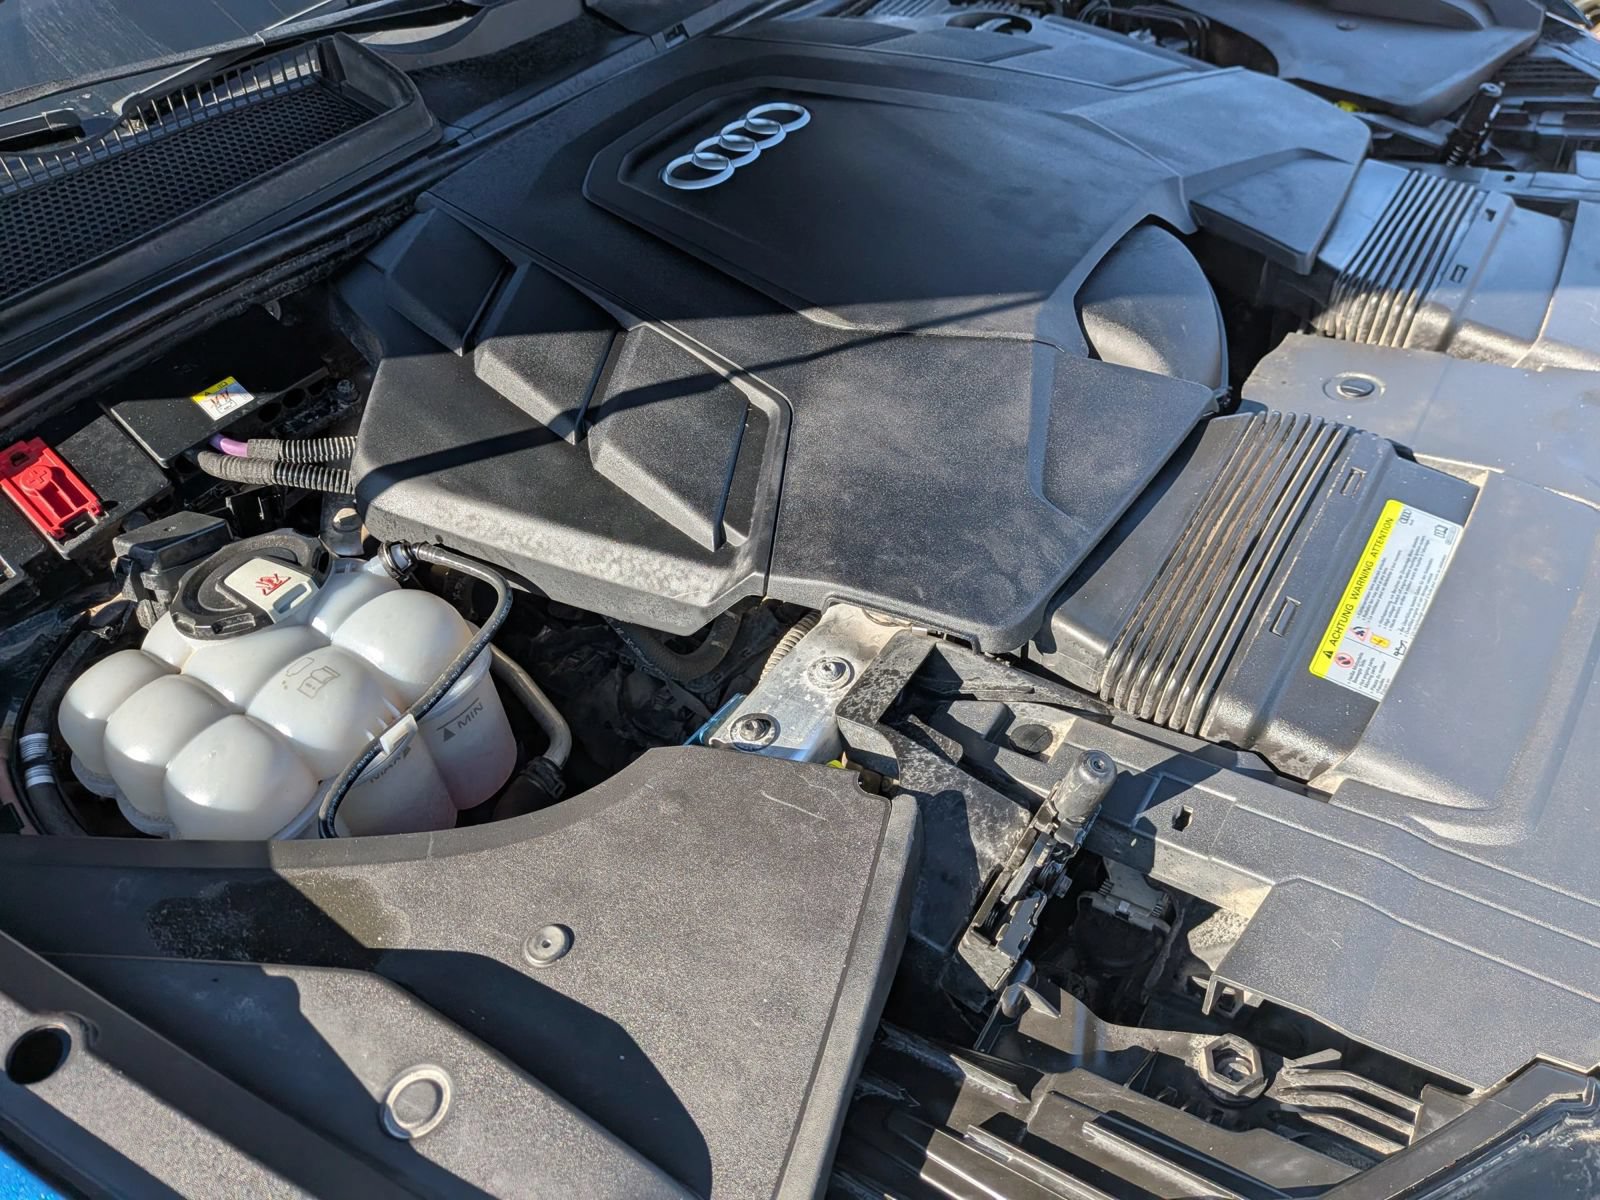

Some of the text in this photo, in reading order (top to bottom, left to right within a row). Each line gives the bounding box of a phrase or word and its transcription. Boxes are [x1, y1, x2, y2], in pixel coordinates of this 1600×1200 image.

[1330, 604, 1354, 647] ACHTUNG
[1350, 561, 1373, 600] WARNING
[1372, 518, 1394, 558] ATTENTION
[457, 701, 484, 729] MIN
